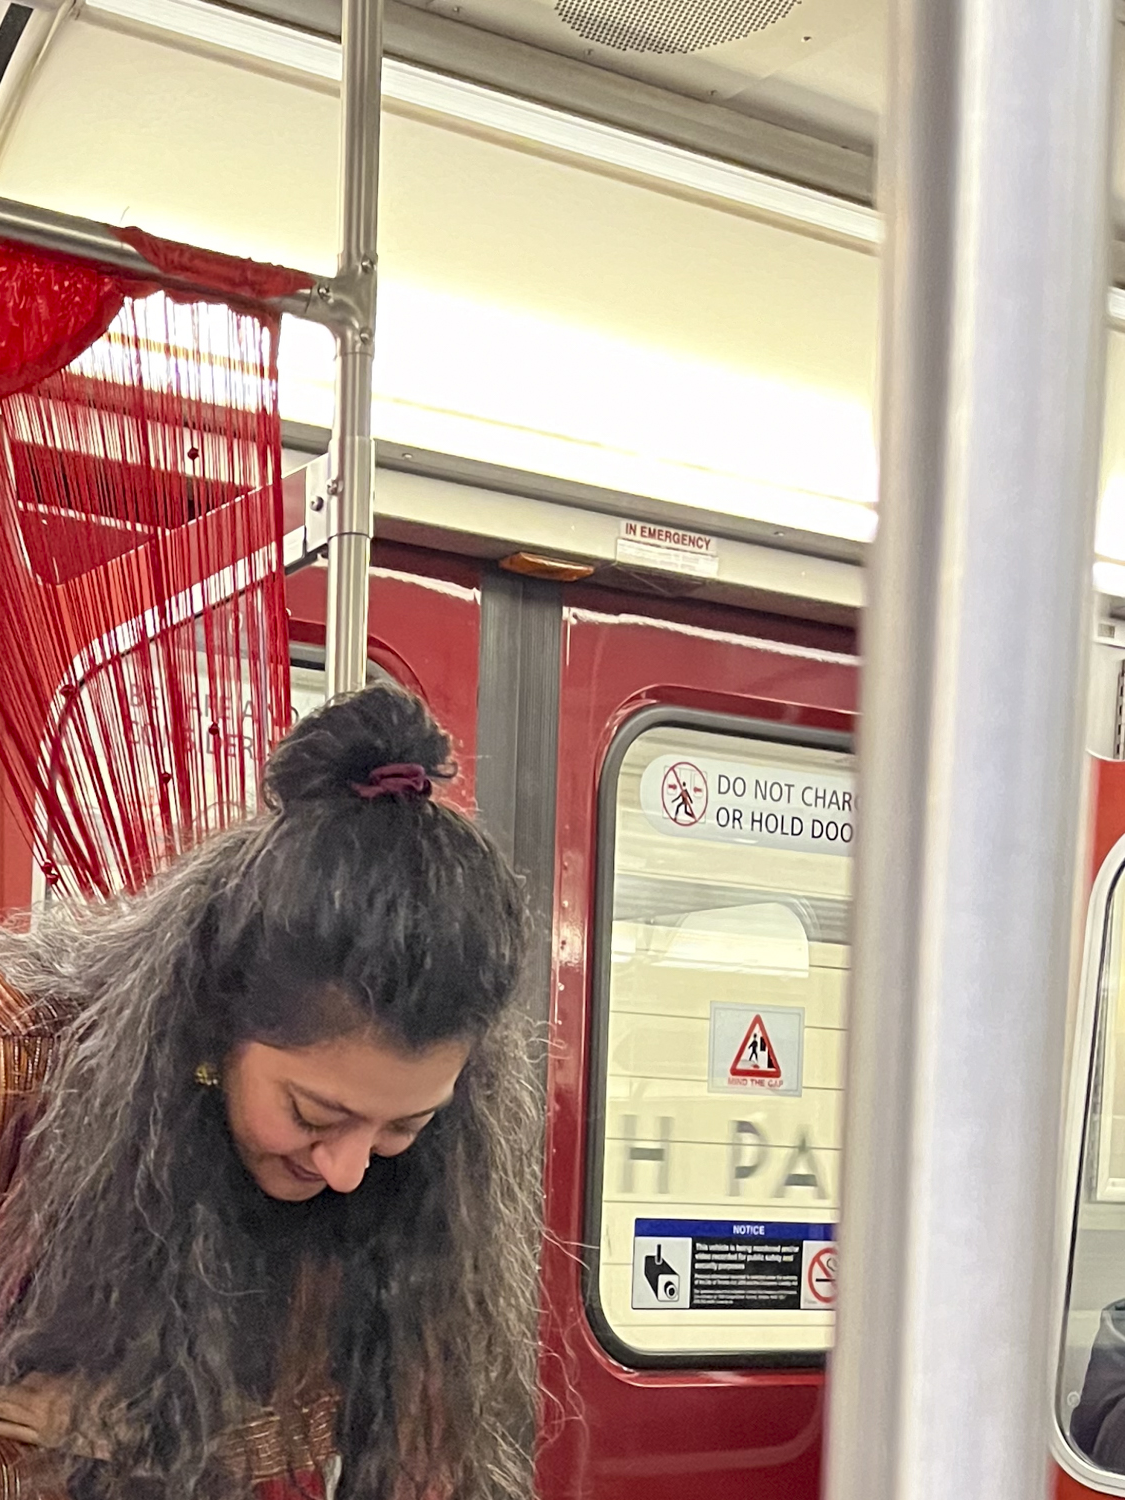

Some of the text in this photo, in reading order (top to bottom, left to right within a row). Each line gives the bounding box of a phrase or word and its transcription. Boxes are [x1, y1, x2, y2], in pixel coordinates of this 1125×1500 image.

[625, 522, 711, 551] IN EMERGENCY
[717, 774, 860, 813] DO NOT CHAR
[716, 806, 854, 844] OR HOLD DOO
[618, 1113, 832, 1200] H PA
[732, 1224, 765, 1236] NOTICE
